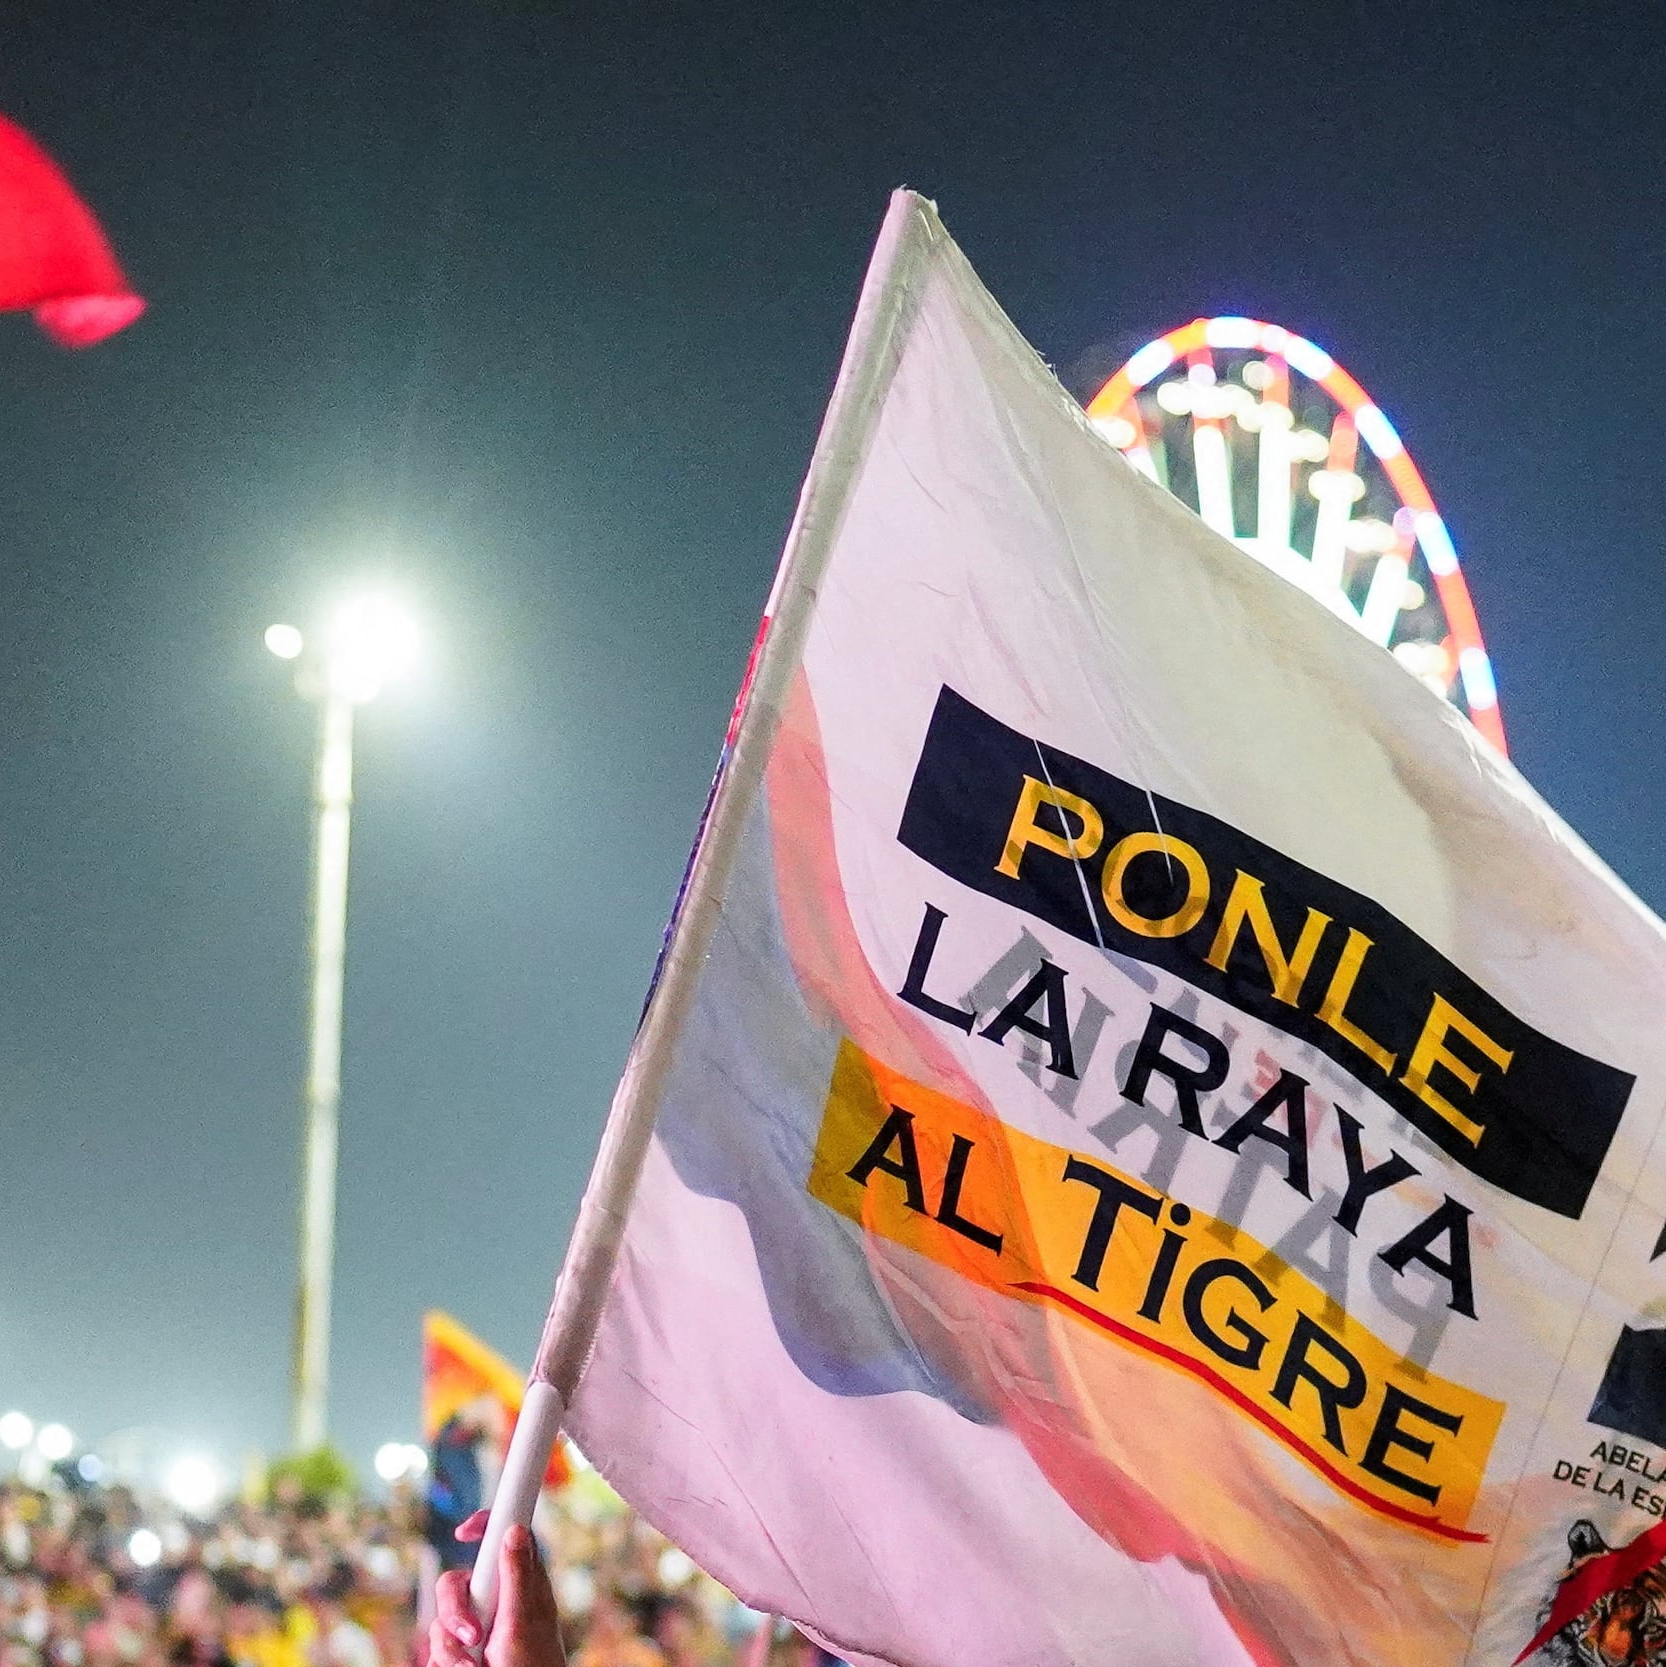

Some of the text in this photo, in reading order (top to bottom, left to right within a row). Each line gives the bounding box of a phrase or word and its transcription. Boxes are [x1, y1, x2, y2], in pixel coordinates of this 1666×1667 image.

[993, 774, 1514, 1149] PONLE
[846, 1104, 1004, 1256] AL
[895, 903, 1079, 1081] LA
[1120, 1002, 1481, 1320] RAYA
[1552, 1460, 1587, 1488] DE
[1592, 1470, 1626, 1502] LA
